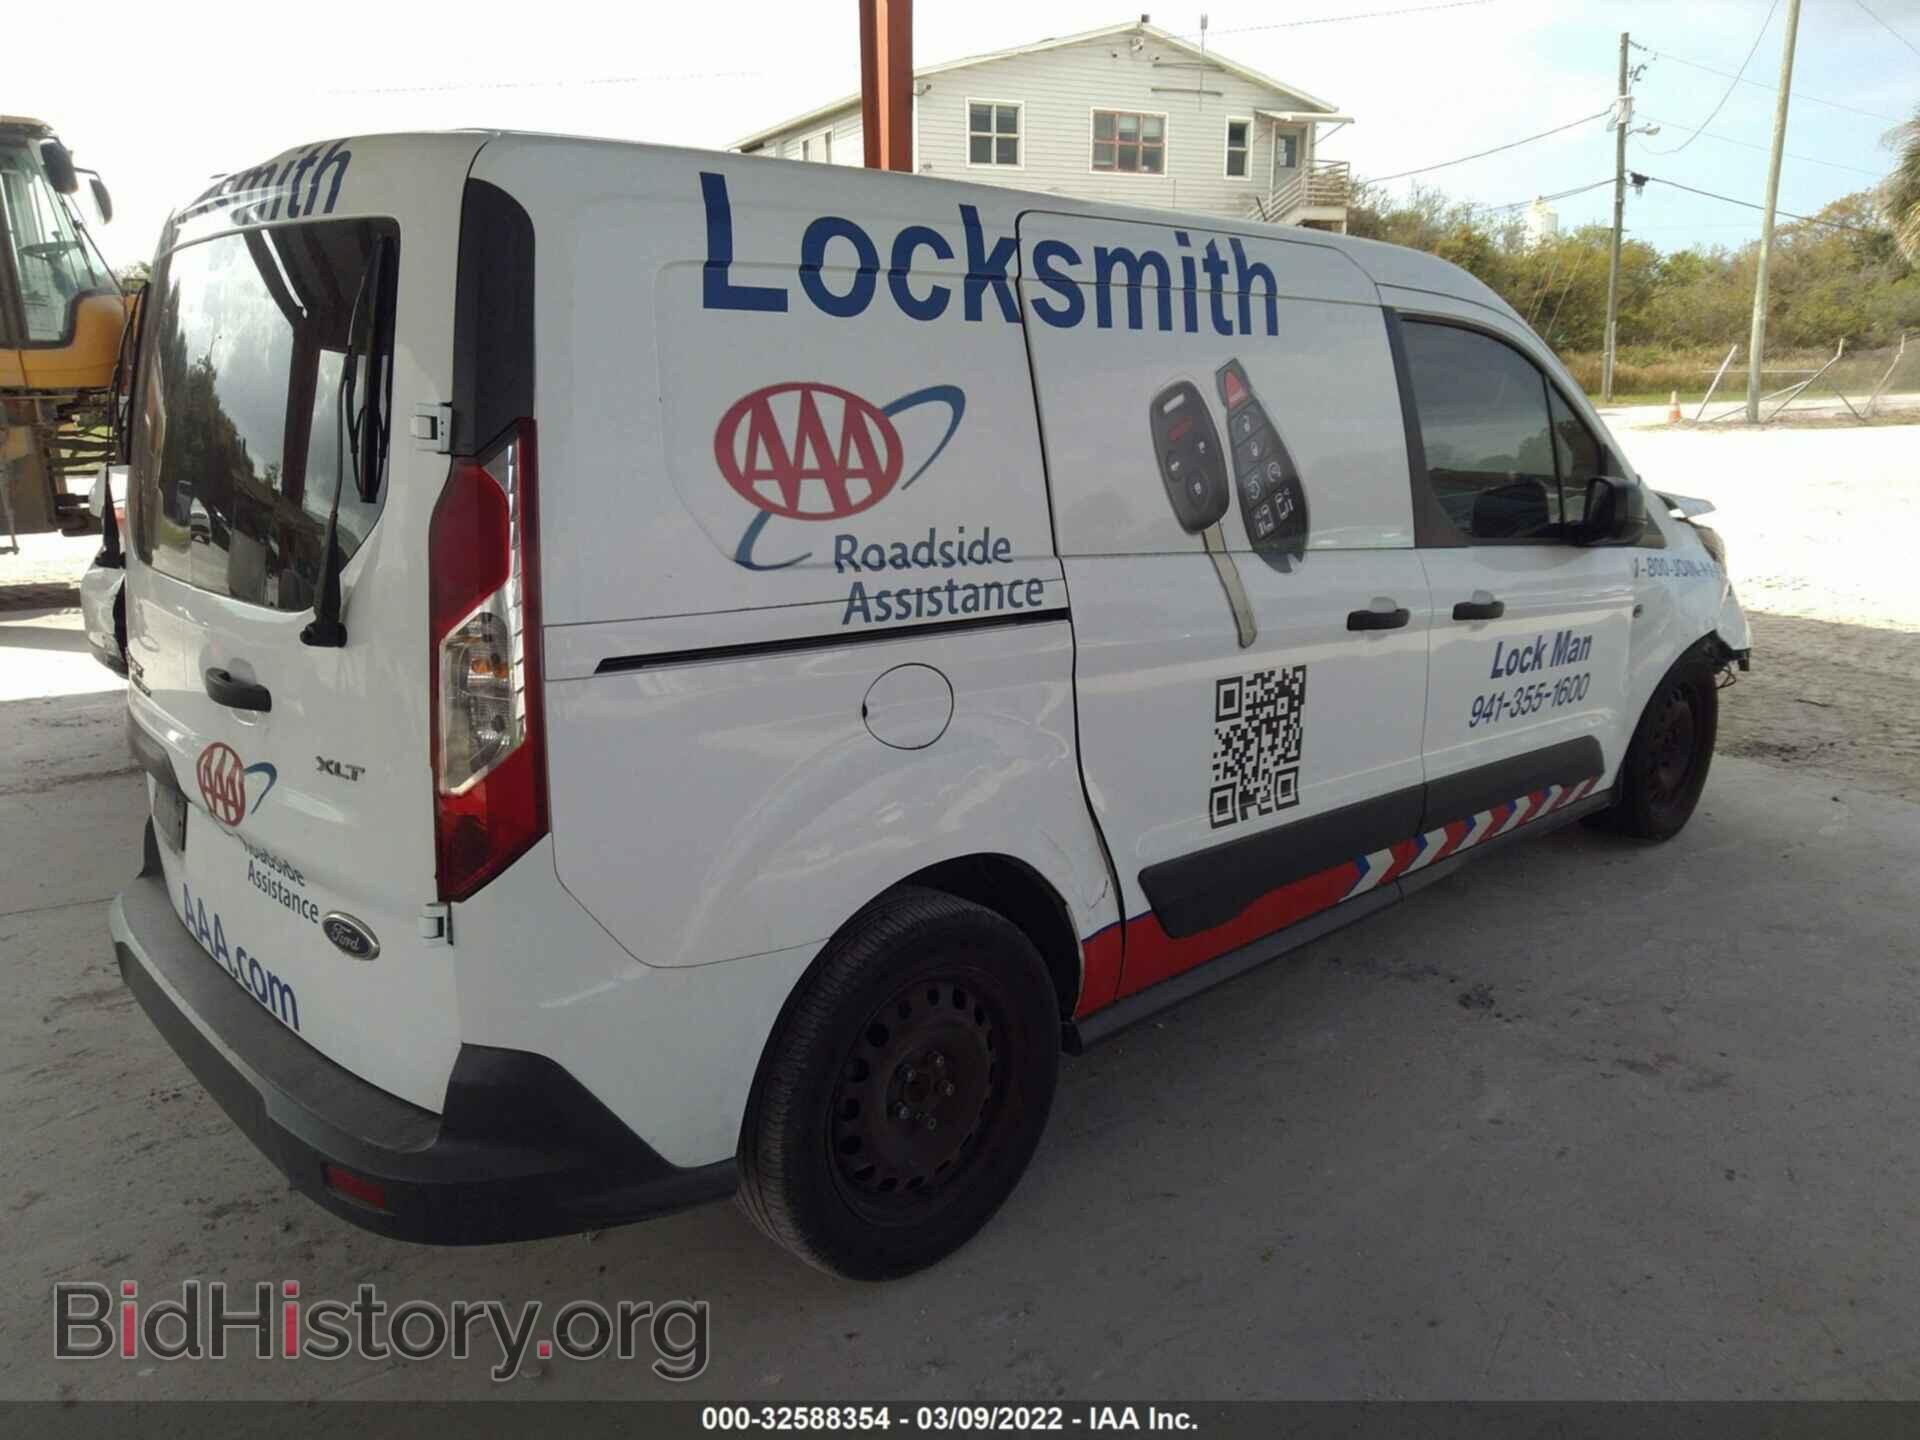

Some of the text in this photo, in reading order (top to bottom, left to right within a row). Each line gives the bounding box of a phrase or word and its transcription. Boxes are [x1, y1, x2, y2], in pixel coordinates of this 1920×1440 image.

[700, 171, 1279, 336] Locksmith
[728, 383, 894, 518] AAA
[834, 526, 1014, 572] Roadside
[841, 576, 1044, 625] Assistance
[1490, 630, 1593, 679] Lock Man
[1469, 672, 1591, 728] 941-355-1600
[199, 745, 244, 825] AAA
[315, 755, 366, 782] XLT
[247, 859, 319, 924] Assistance
[183, 882, 300, 1033] AAA.com
[329, 922, 361, 951] Ford
